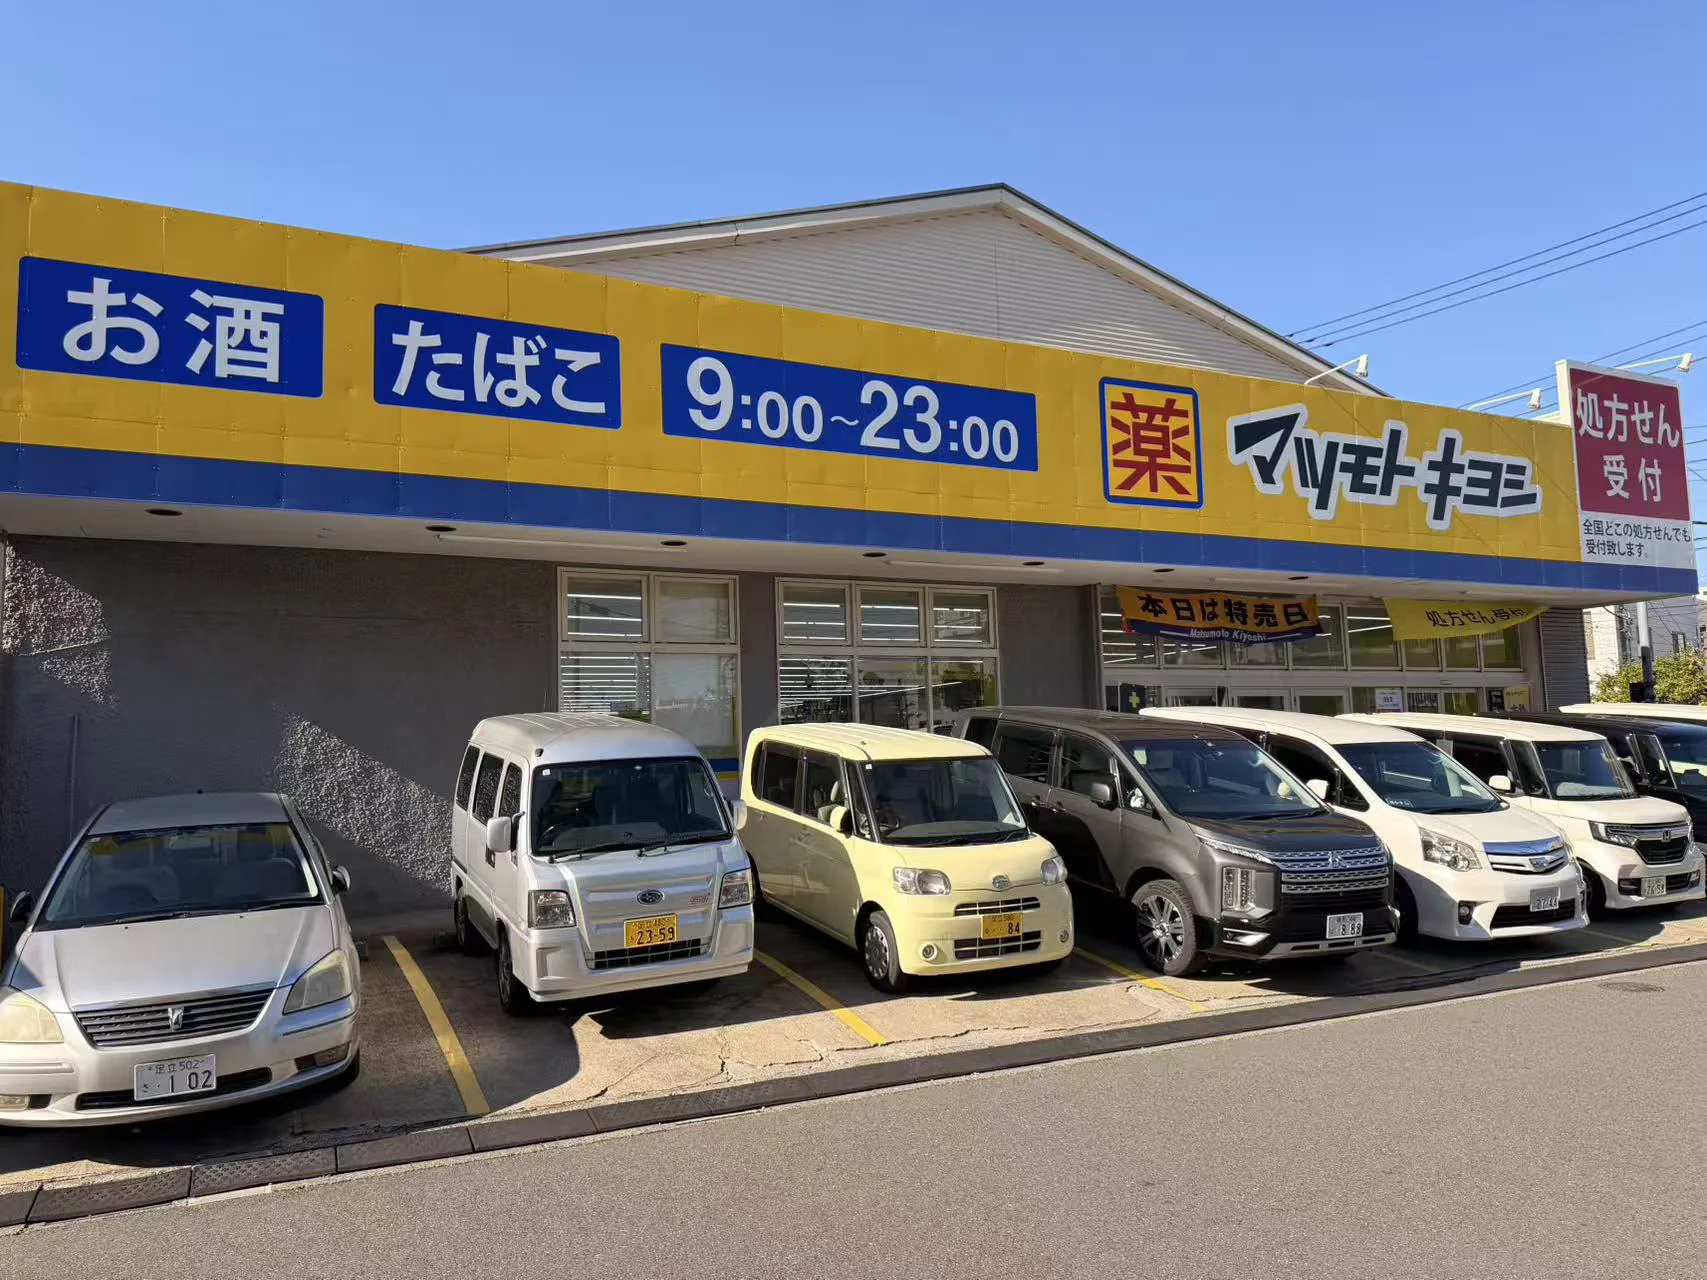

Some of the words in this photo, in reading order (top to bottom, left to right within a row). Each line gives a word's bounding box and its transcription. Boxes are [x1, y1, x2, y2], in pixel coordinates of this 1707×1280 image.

[63, 277, 284, 383] お酒
[392, 320, 606, 413] たばこ
[1576, 388, 1680, 448] 処方せん
[1110, 392, 1192, 496] 薬
[1230, 408, 1541, 525] マツモトキヨシ
[1603, 454, 1662, 503] 受付
[1583, 518, 1691, 543] 全国どこの処方せんでも
[1586, 538, 1649, 558] 受付致します。
[1137, 594, 1308, 627] 本日は特売日
[1190, 628, 1230, 639] Matsumoto
[1232, 630, 1267, 642] Kiyoshi
[637, 927, 674, 944] 23-59
[156, 1063, 176, 1074] 足立
[179, 1059, 199, 1071] 502
